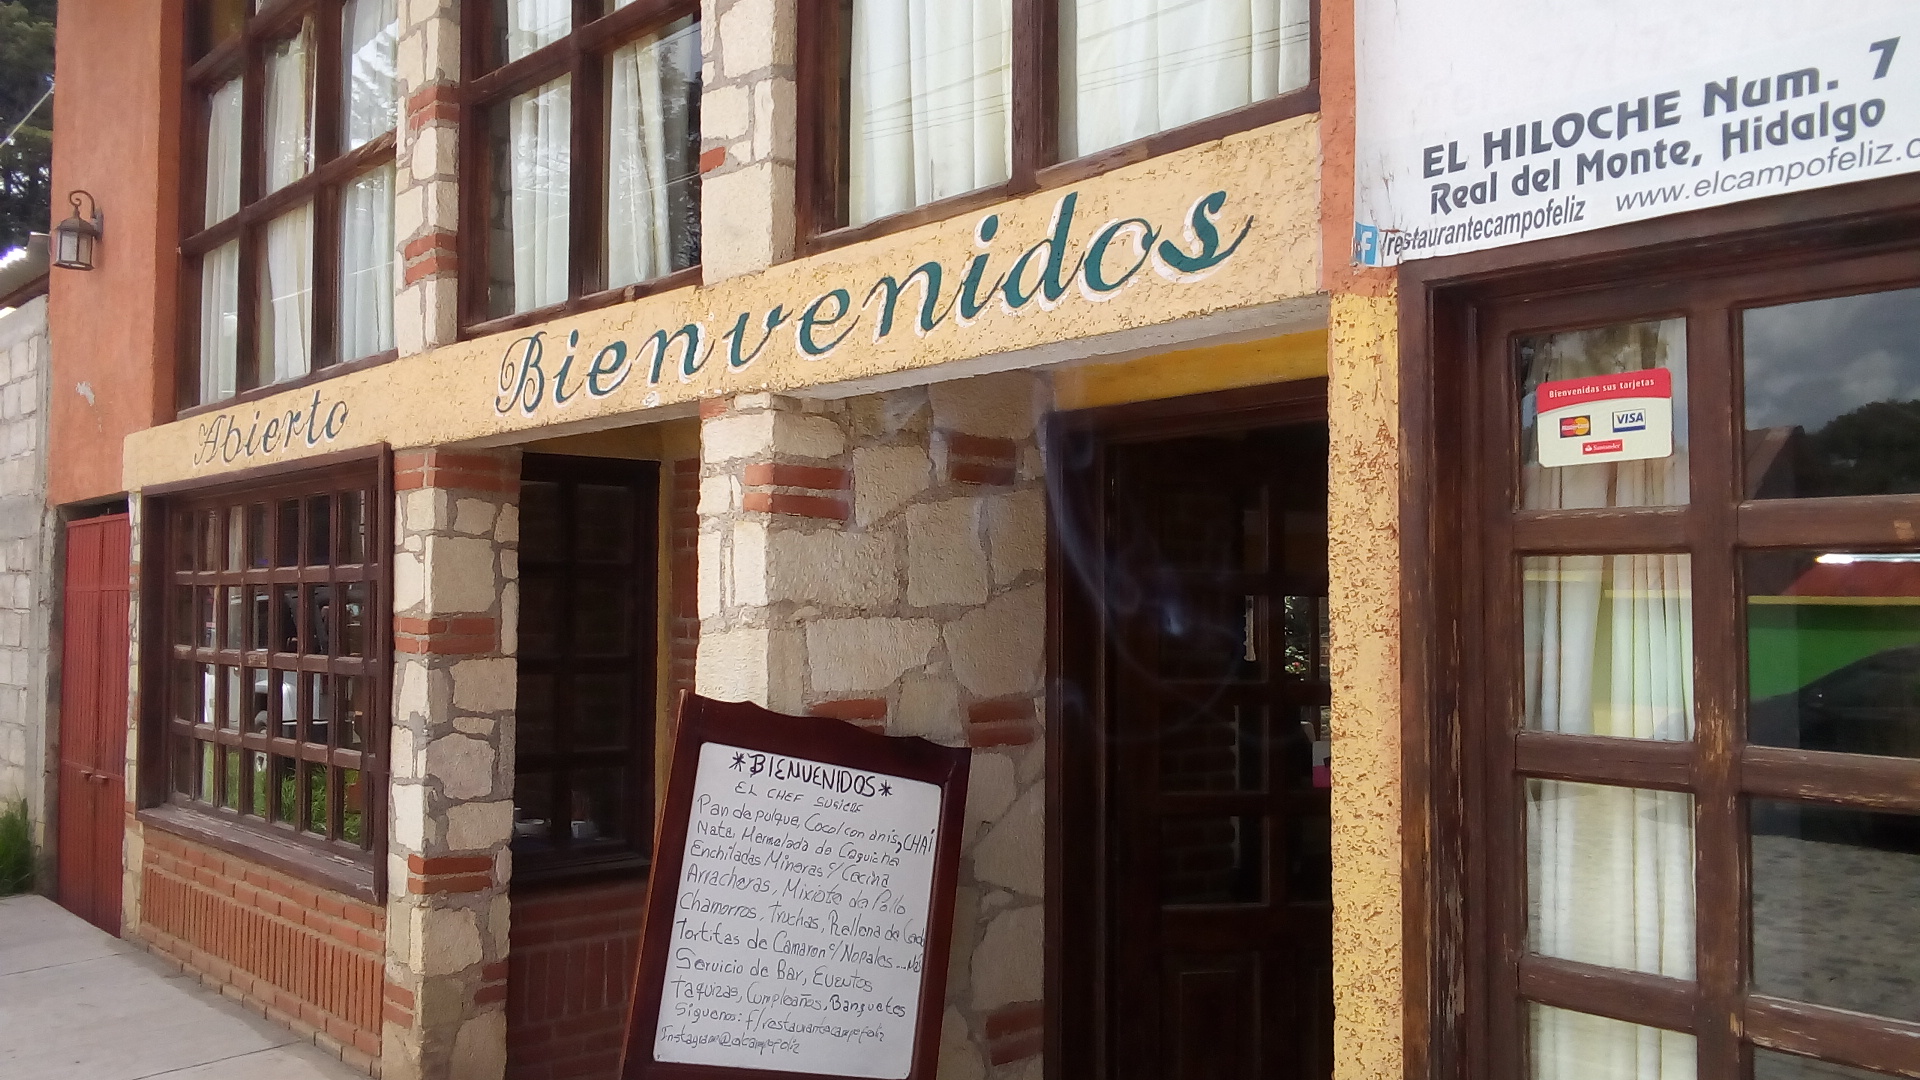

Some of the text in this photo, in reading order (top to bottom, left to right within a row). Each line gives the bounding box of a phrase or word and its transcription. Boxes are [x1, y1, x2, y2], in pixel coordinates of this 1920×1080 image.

[1423, 139, 1467, 179] EL
[1484, 90, 1682, 168] HILOCHE
[1703, 67, 1839, 119] Num.
[1868, 36, 1901, 80] 7
[1430, 98, 1886, 215] Real del Monte, Hidalgo
[495, 190, 1255, 418] Bienvenidos
[1549, 378, 1655, 399] Bienvenidas sus tarjetas
[193, 389, 350, 467] Abierto
[1616, 412, 1644, 424] VISA
[697, 793, 729, 817] Pan
[732, 803, 753, 820] de
[734, 781, 758, 797] EL
[767, 788, 805, 803] CHEF
[763, 850, 823, 879] Mineras
[676, 918, 740, 945] Tortitas
[747, 927, 768, 950] de
[676, 947, 744, 975] Servicio
[749, 958, 769, 978] de
